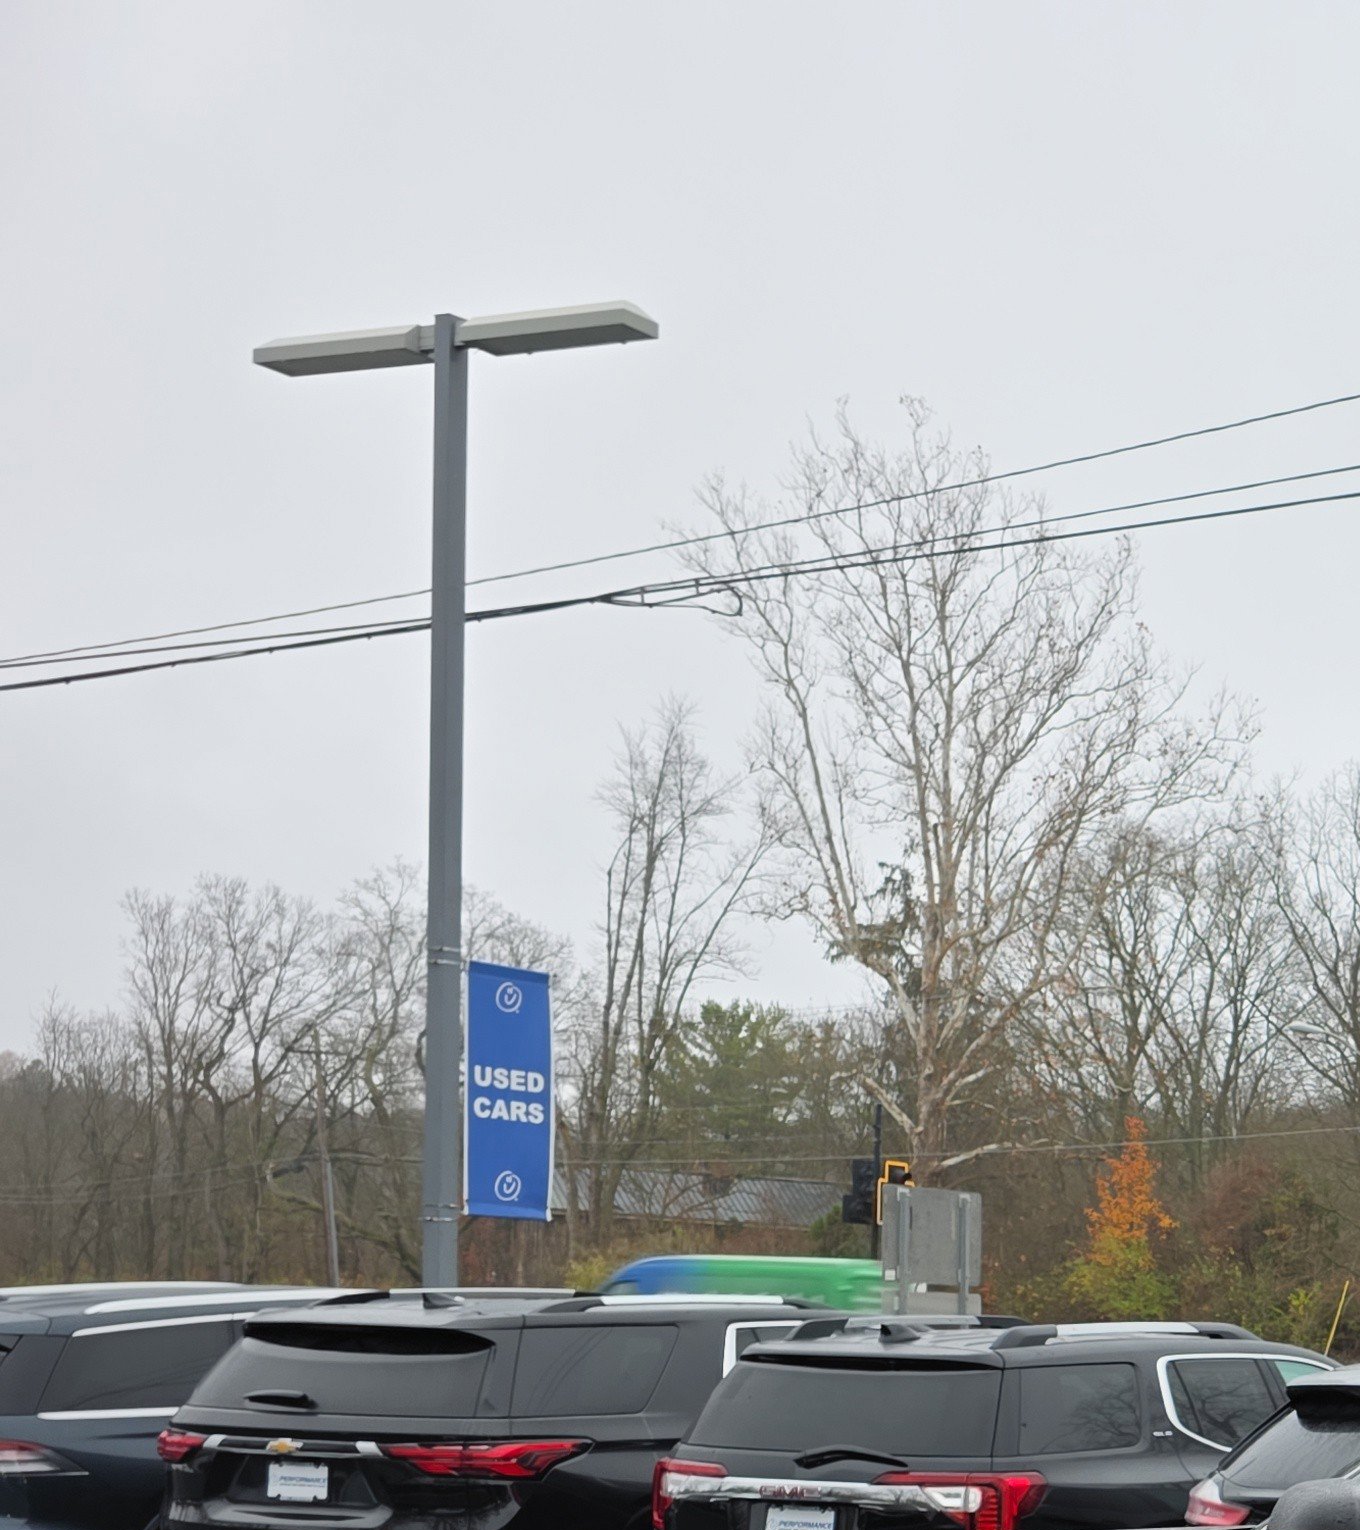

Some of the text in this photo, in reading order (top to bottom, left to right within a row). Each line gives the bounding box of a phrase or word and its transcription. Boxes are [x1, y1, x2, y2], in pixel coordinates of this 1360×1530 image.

[473, 1065, 545, 1094] USED
[473, 1096, 545, 1125] CARS
[759, 1485, 821, 1499] GMC
[778, 1520, 832, 1529] PERFORMANCE
